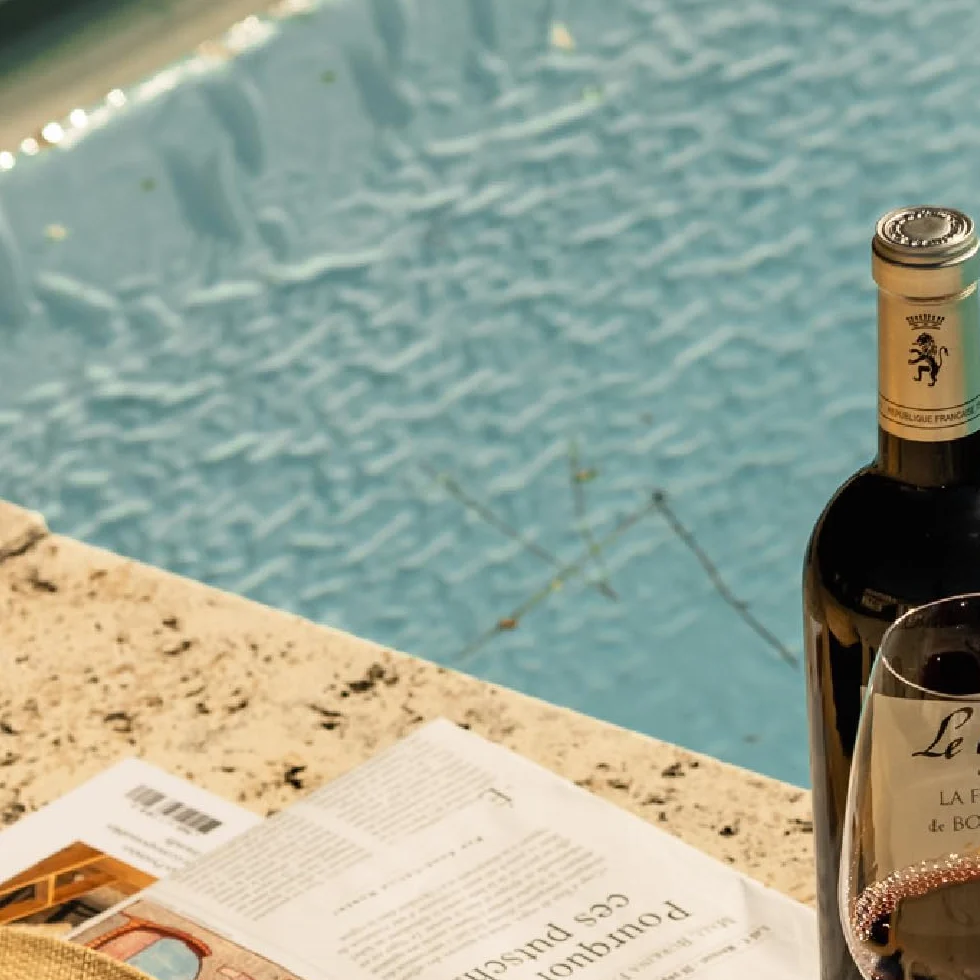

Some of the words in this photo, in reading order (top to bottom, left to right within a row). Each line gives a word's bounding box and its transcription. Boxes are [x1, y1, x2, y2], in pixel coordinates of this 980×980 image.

[912, 706, 974, 760] Le
[939, 790, 964, 806] LA
[928, 818, 945, 833] de
[573, 892, 630, 925] ces
